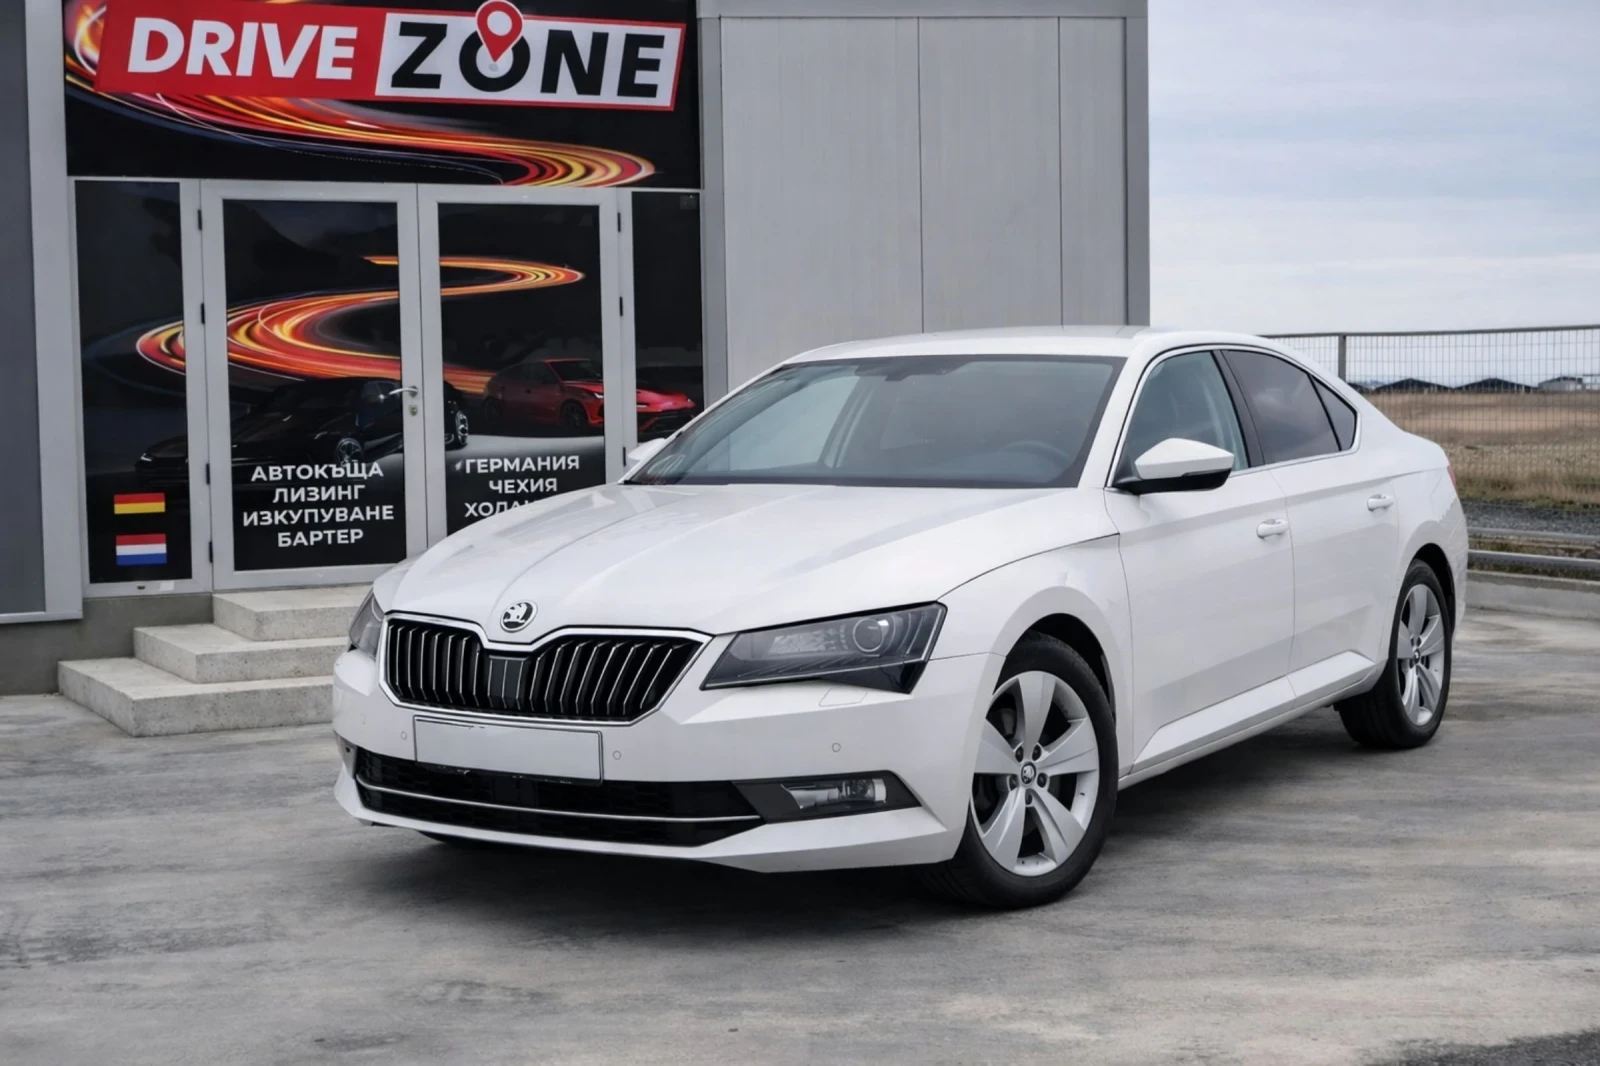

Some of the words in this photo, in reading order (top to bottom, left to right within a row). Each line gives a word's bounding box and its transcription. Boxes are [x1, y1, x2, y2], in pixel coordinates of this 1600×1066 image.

[127, 17, 358, 80] DRIVE
[390, 21, 665, 98] ZONE
[251, 462, 384, 482] АВТОКЪЩА
[465, 455, 580, 473] ГЕРМАНИЯ
[272, 484, 365, 503] ЛИЗИНГ
[489, 477, 558, 494] ЧЕХИЯ
[243, 505, 394, 527] ИЗКУПУВАНЕ
[277, 528, 364, 547] БАРТЕР
